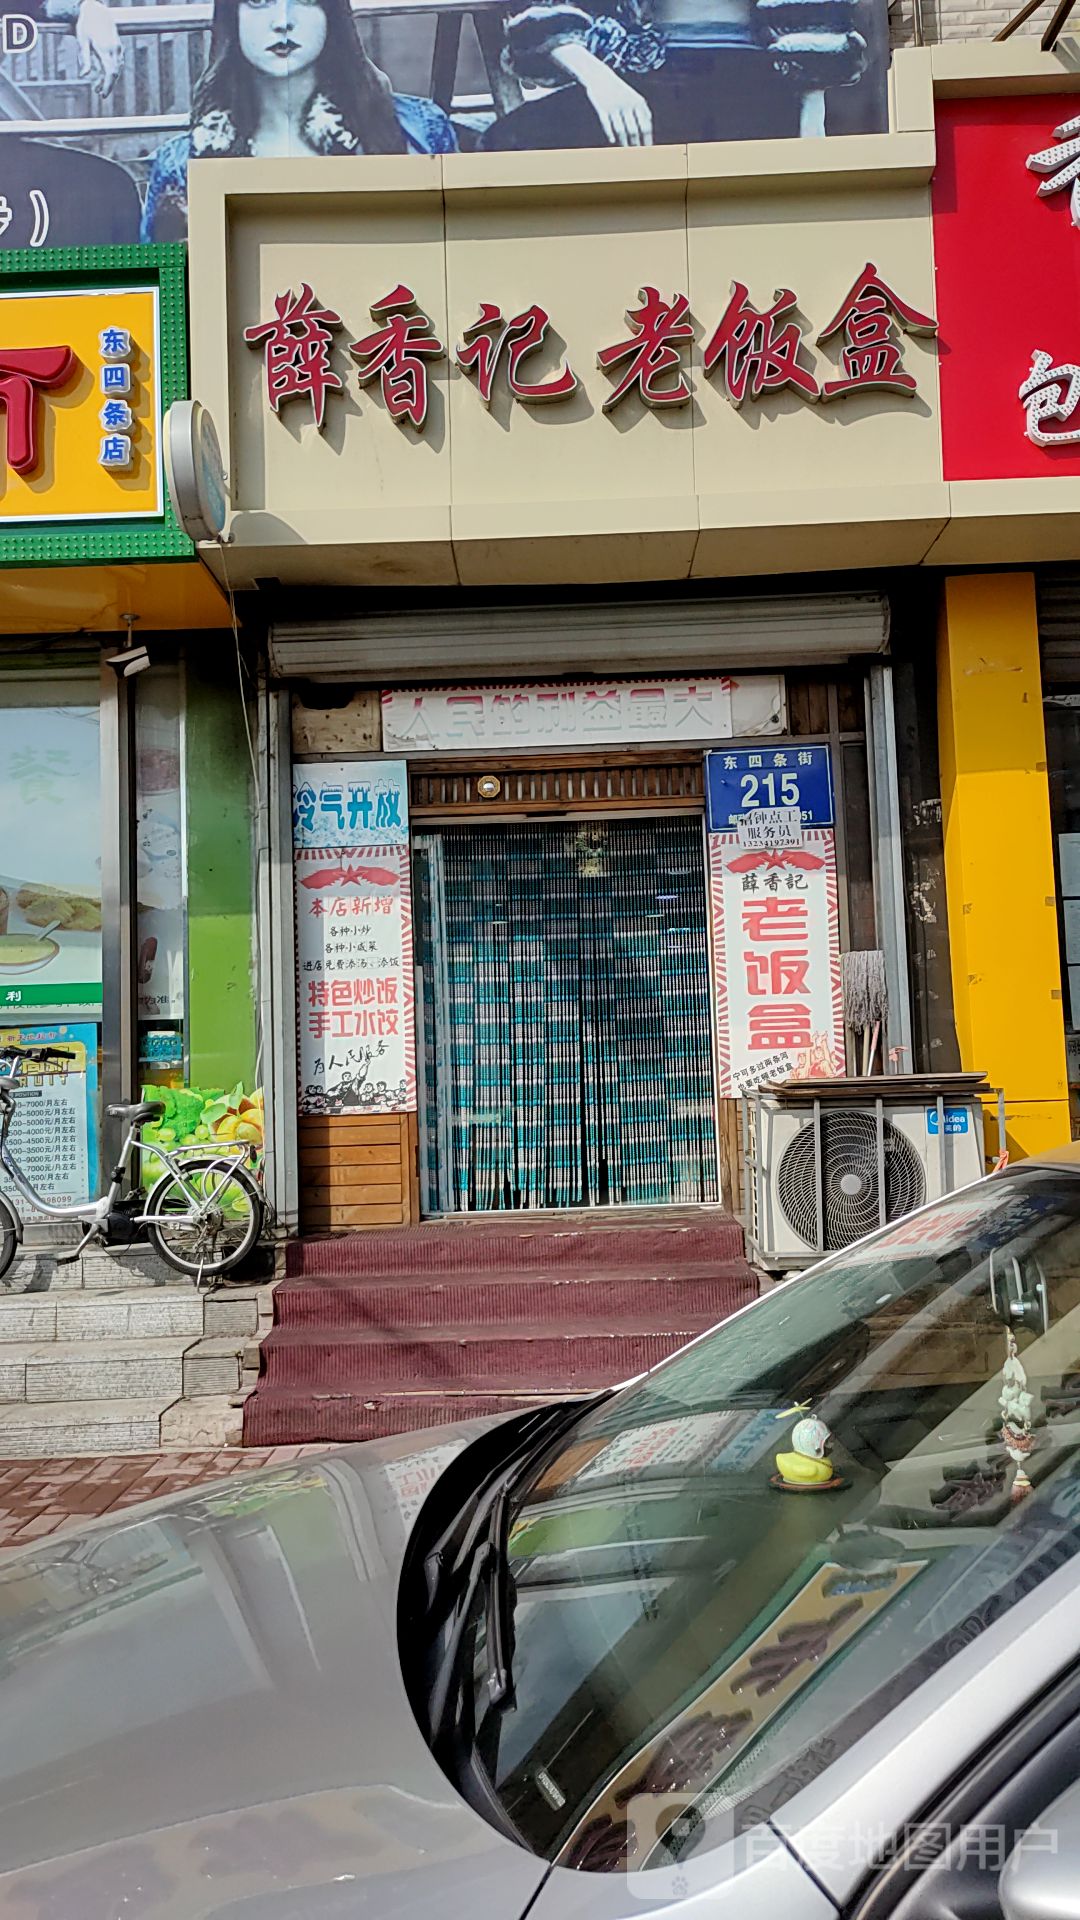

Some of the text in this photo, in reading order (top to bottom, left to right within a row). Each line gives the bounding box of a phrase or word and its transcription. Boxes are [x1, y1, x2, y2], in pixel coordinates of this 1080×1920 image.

[244, 262, 939, 431] 薛香记老饭盒
[99, 327, 132, 467] 东四条店
[723, 751, 812, 770] 东四条街
[740, 772, 800, 808] 215
[293, 779, 401, 832] 冷气开放
[747, 825, 791, 840] 服务员
[741, 872, 809, 894] 薛香記
[308, 895, 393, 917] 本店新增
[330, 925, 372, 937] 各种小炒
[741, 896, 814, 1051] 老饭盒
[308, 977, 398, 1007] 特色炒饭
[309, 1009, 399, 1039] 手工水饺
[313, 1040, 390, 1076] 为人民服务
[733, 1051, 789, 1080] 宁可多过两条河
[943, 1114, 966, 1123] idea
